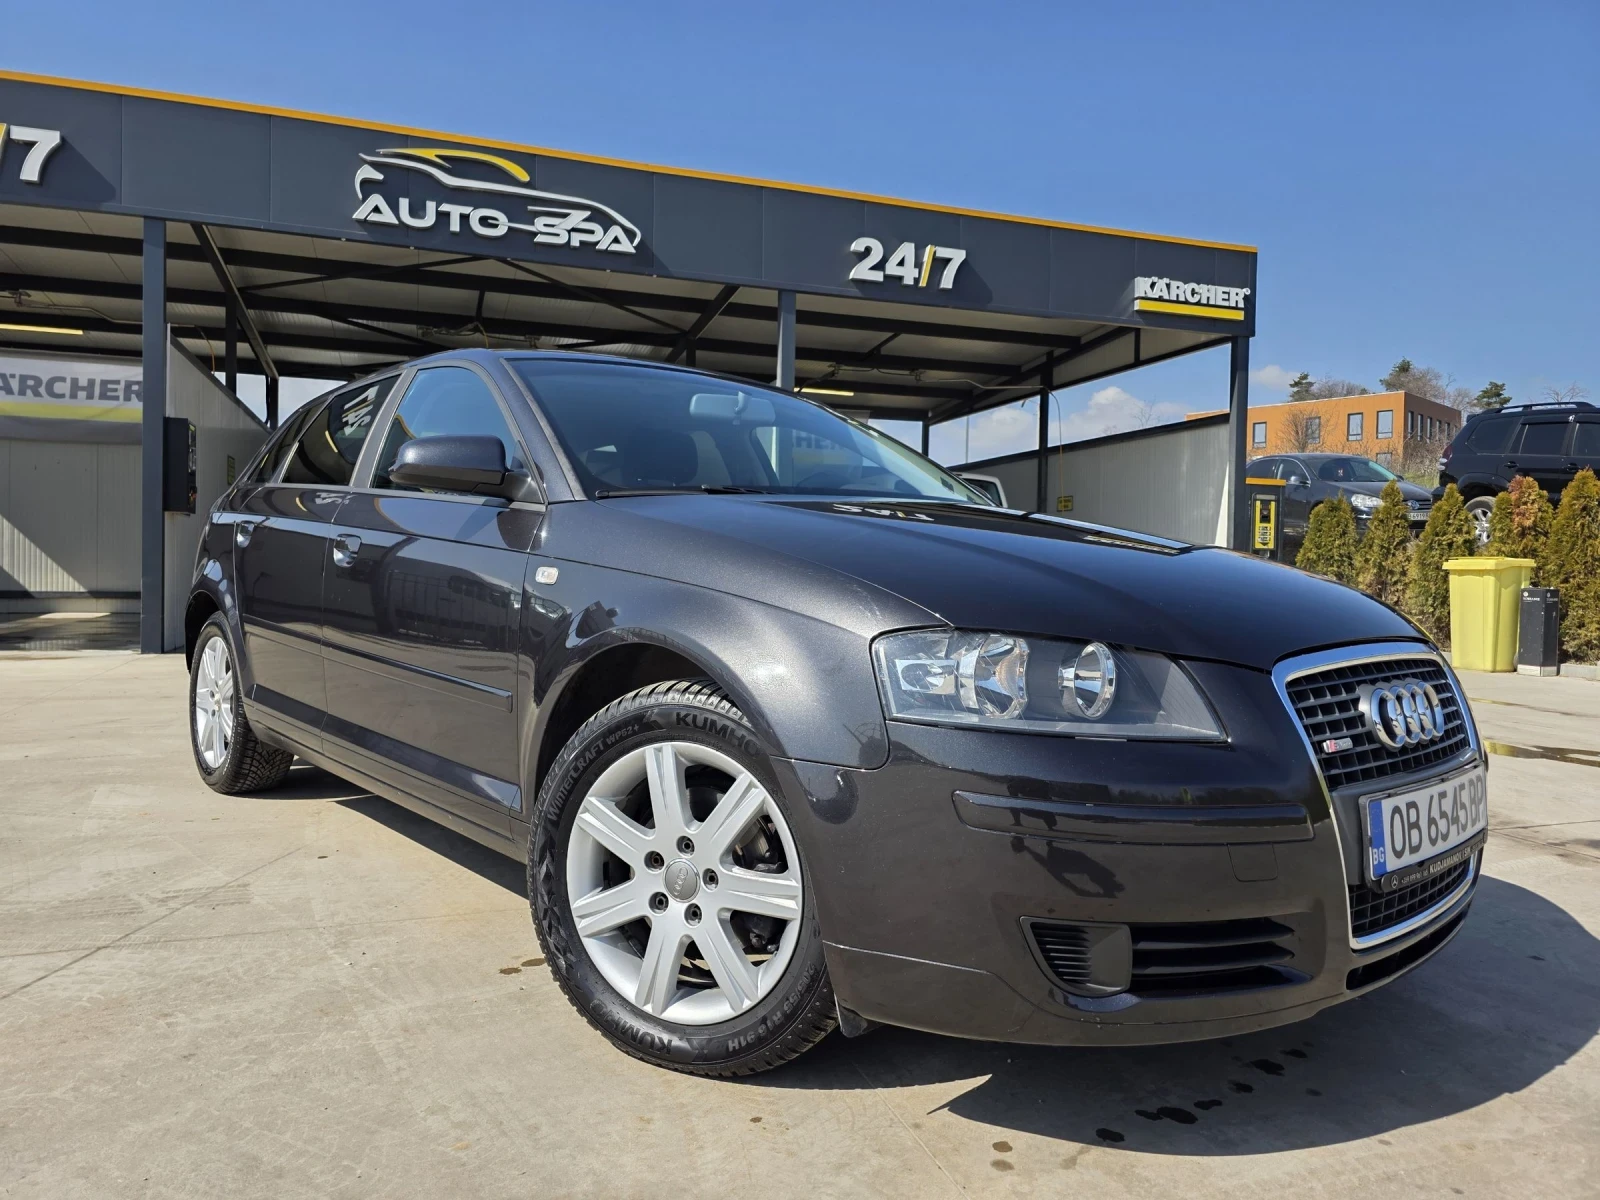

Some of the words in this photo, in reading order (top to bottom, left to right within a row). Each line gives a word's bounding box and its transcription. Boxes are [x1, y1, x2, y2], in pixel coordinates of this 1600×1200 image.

[352, 194, 508, 238] AUTO
[528, 206, 637, 253] SPA
[849, 237, 967, 289] 24/7
[1134, 276, 1246, 309] KÄRCHER
[675, 711, 761, 757] KUMHO
[1390, 800, 1422, 859] OB
[1427, 783, 1468, 847] 6545
[1468, 774, 1484, 828] BP
[1372, 847, 1385, 865] BG
[728, 1031, 756, 1052] 91H
